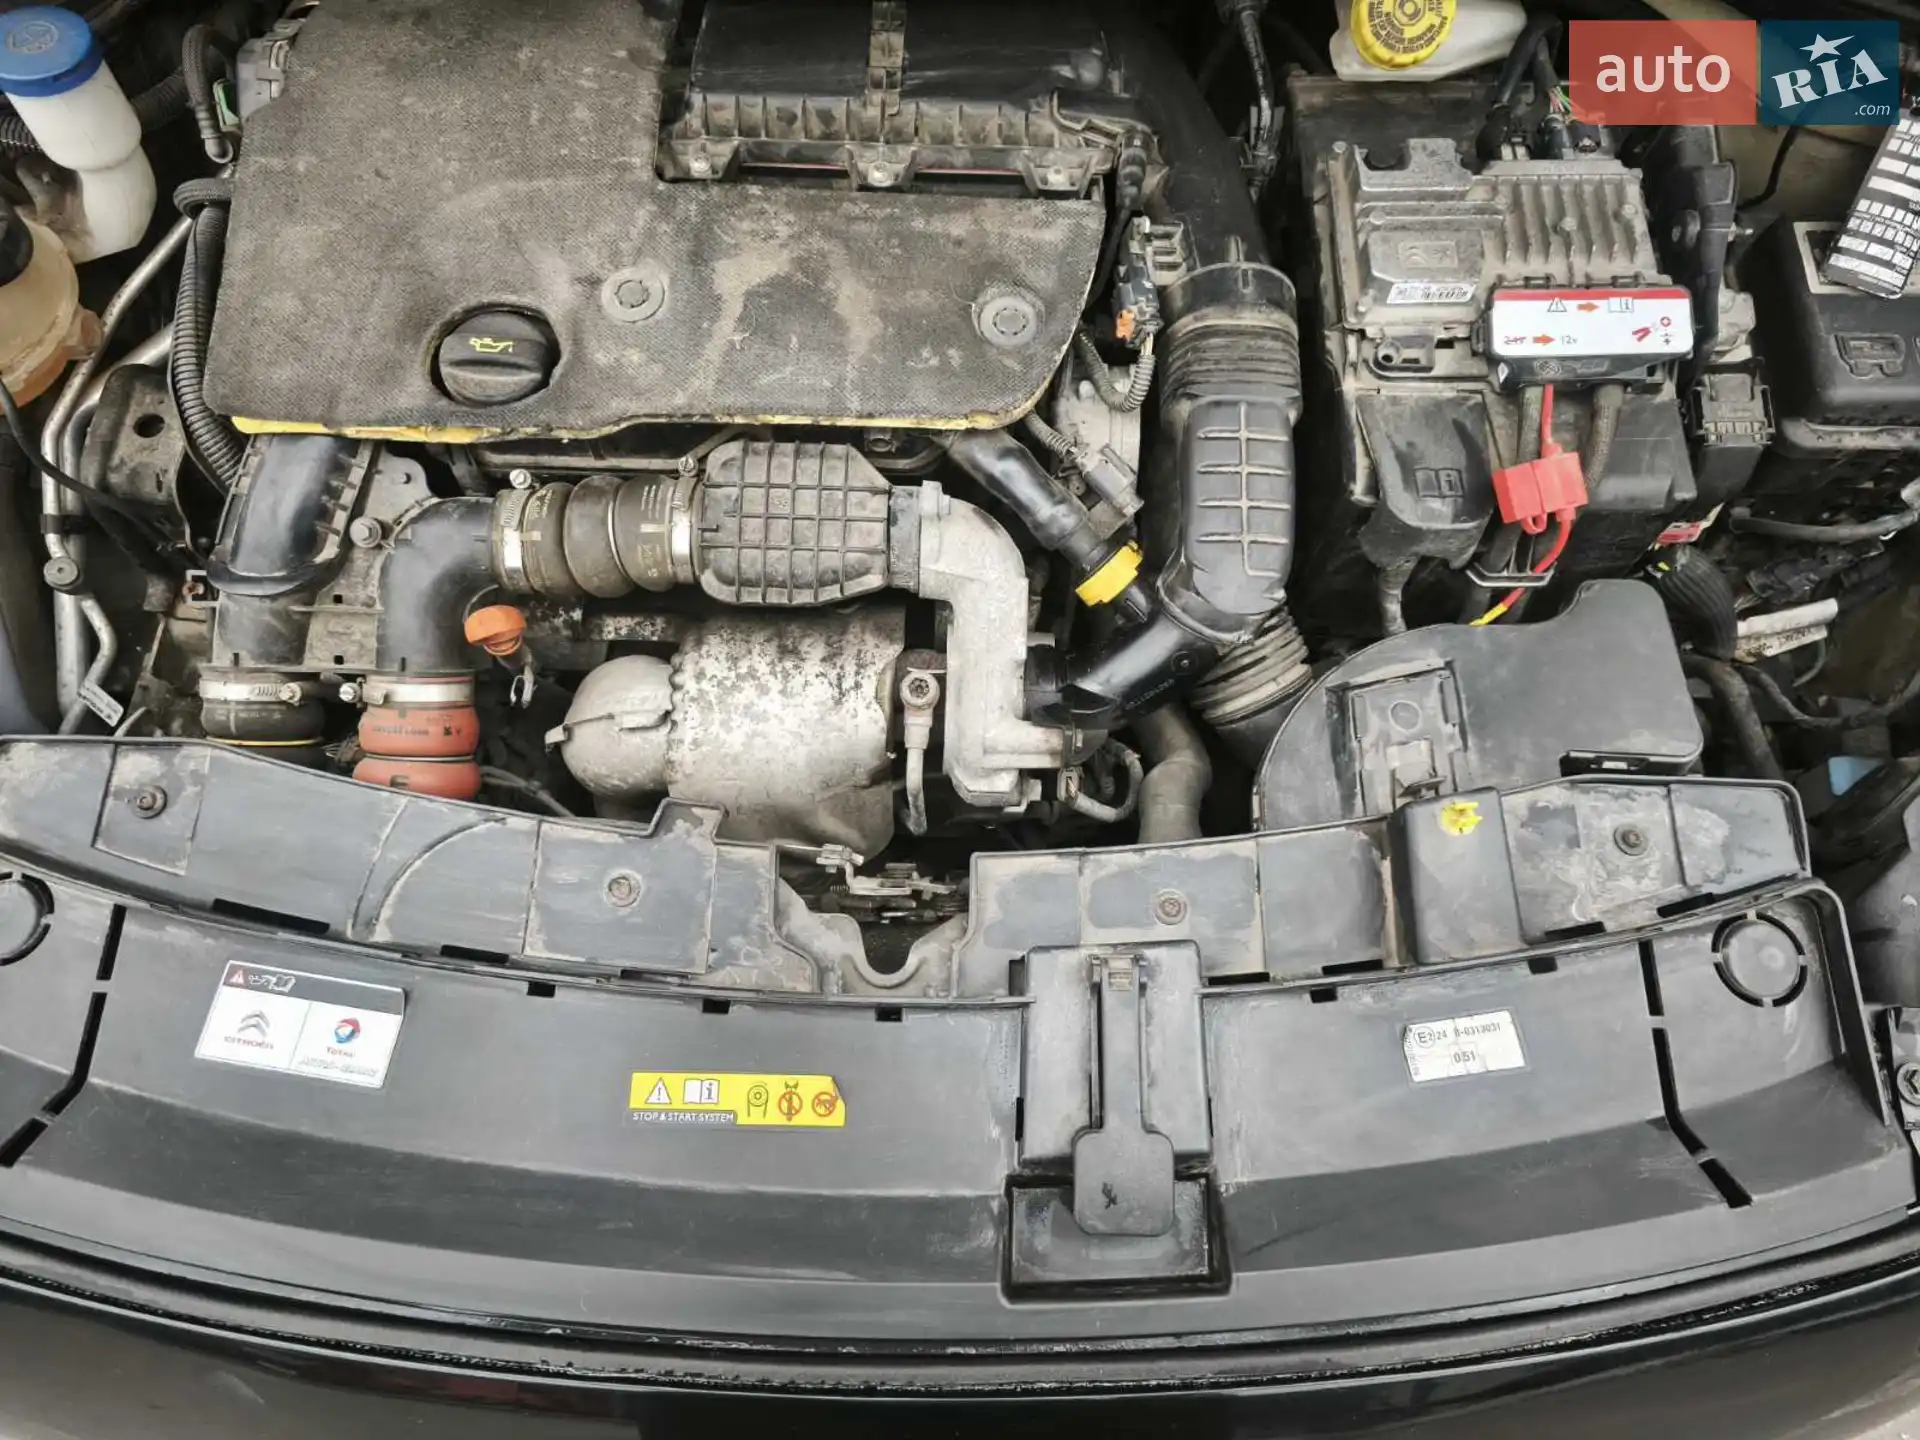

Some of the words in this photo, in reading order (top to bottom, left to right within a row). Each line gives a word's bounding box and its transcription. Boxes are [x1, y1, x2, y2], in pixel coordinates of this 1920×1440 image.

[632, 1111, 659, 1121] STOP
[667, 1112, 697, 1122] START
[698, 1112, 734, 1122] SYSTEM
